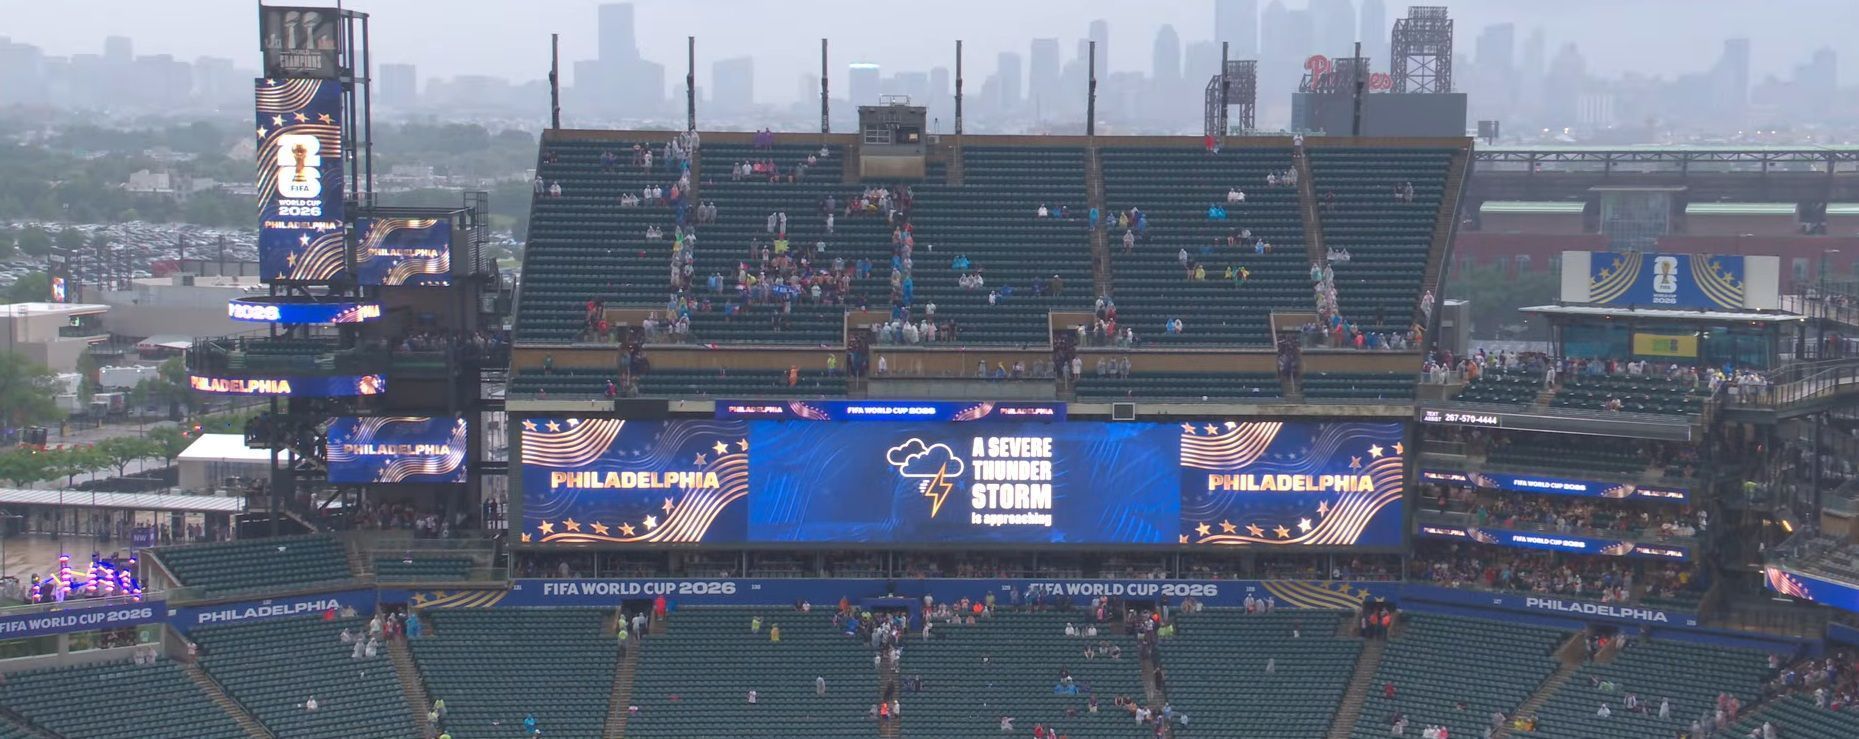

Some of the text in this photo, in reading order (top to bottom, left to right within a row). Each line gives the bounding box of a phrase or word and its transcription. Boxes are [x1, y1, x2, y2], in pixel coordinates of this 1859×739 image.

[280, 55, 321, 68] CHAMPIONS
[278, 206, 322, 216] 2026
[265, 221, 336, 229] PHILADELPHIA
[367, 248, 438, 257] PHILADELPHIA
[190, 375, 292, 393] PHILADELPHIA
[1000, 407, 1054, 415] PHILADELPHIA
[1445, 413, 1497, 424] 267-570-4444
[343, 444, 451, 455] PHILADELPHIA
[972, 437, 1052, 457] A SEVERE
[972, 460, 1052, 480] THUNDER
[1424, 472, 1466, 481] PHILADELPHIA
[551, 471, 720, 489] PHILADELPHIA
[1208, 473, 1375, 492] PHILADELPHIA
[1527, 480, 1550, 488] WORLD
[971, 483, 1052, 509] STORM
[983, 512, 1052, 526] approaching
[1423, 527, 1465, 536] PHILADELPHIA
[1526, 536, 1549, 544] WORLD
[543, 582, 737, 595] FIFA WORLD CUP 2026
[1066, 583, 1125, 595] WORLD
[1127, 583, 1159, 595] CUP
[1161, 583, 1218, 596] 2026
[198, 599, 340, 624] PHILADELPHIA
[1525, 597, 1668, 623] PHILADELPHIA
[0, 608, 152, 632] FIFA WORLD CUP 2026
